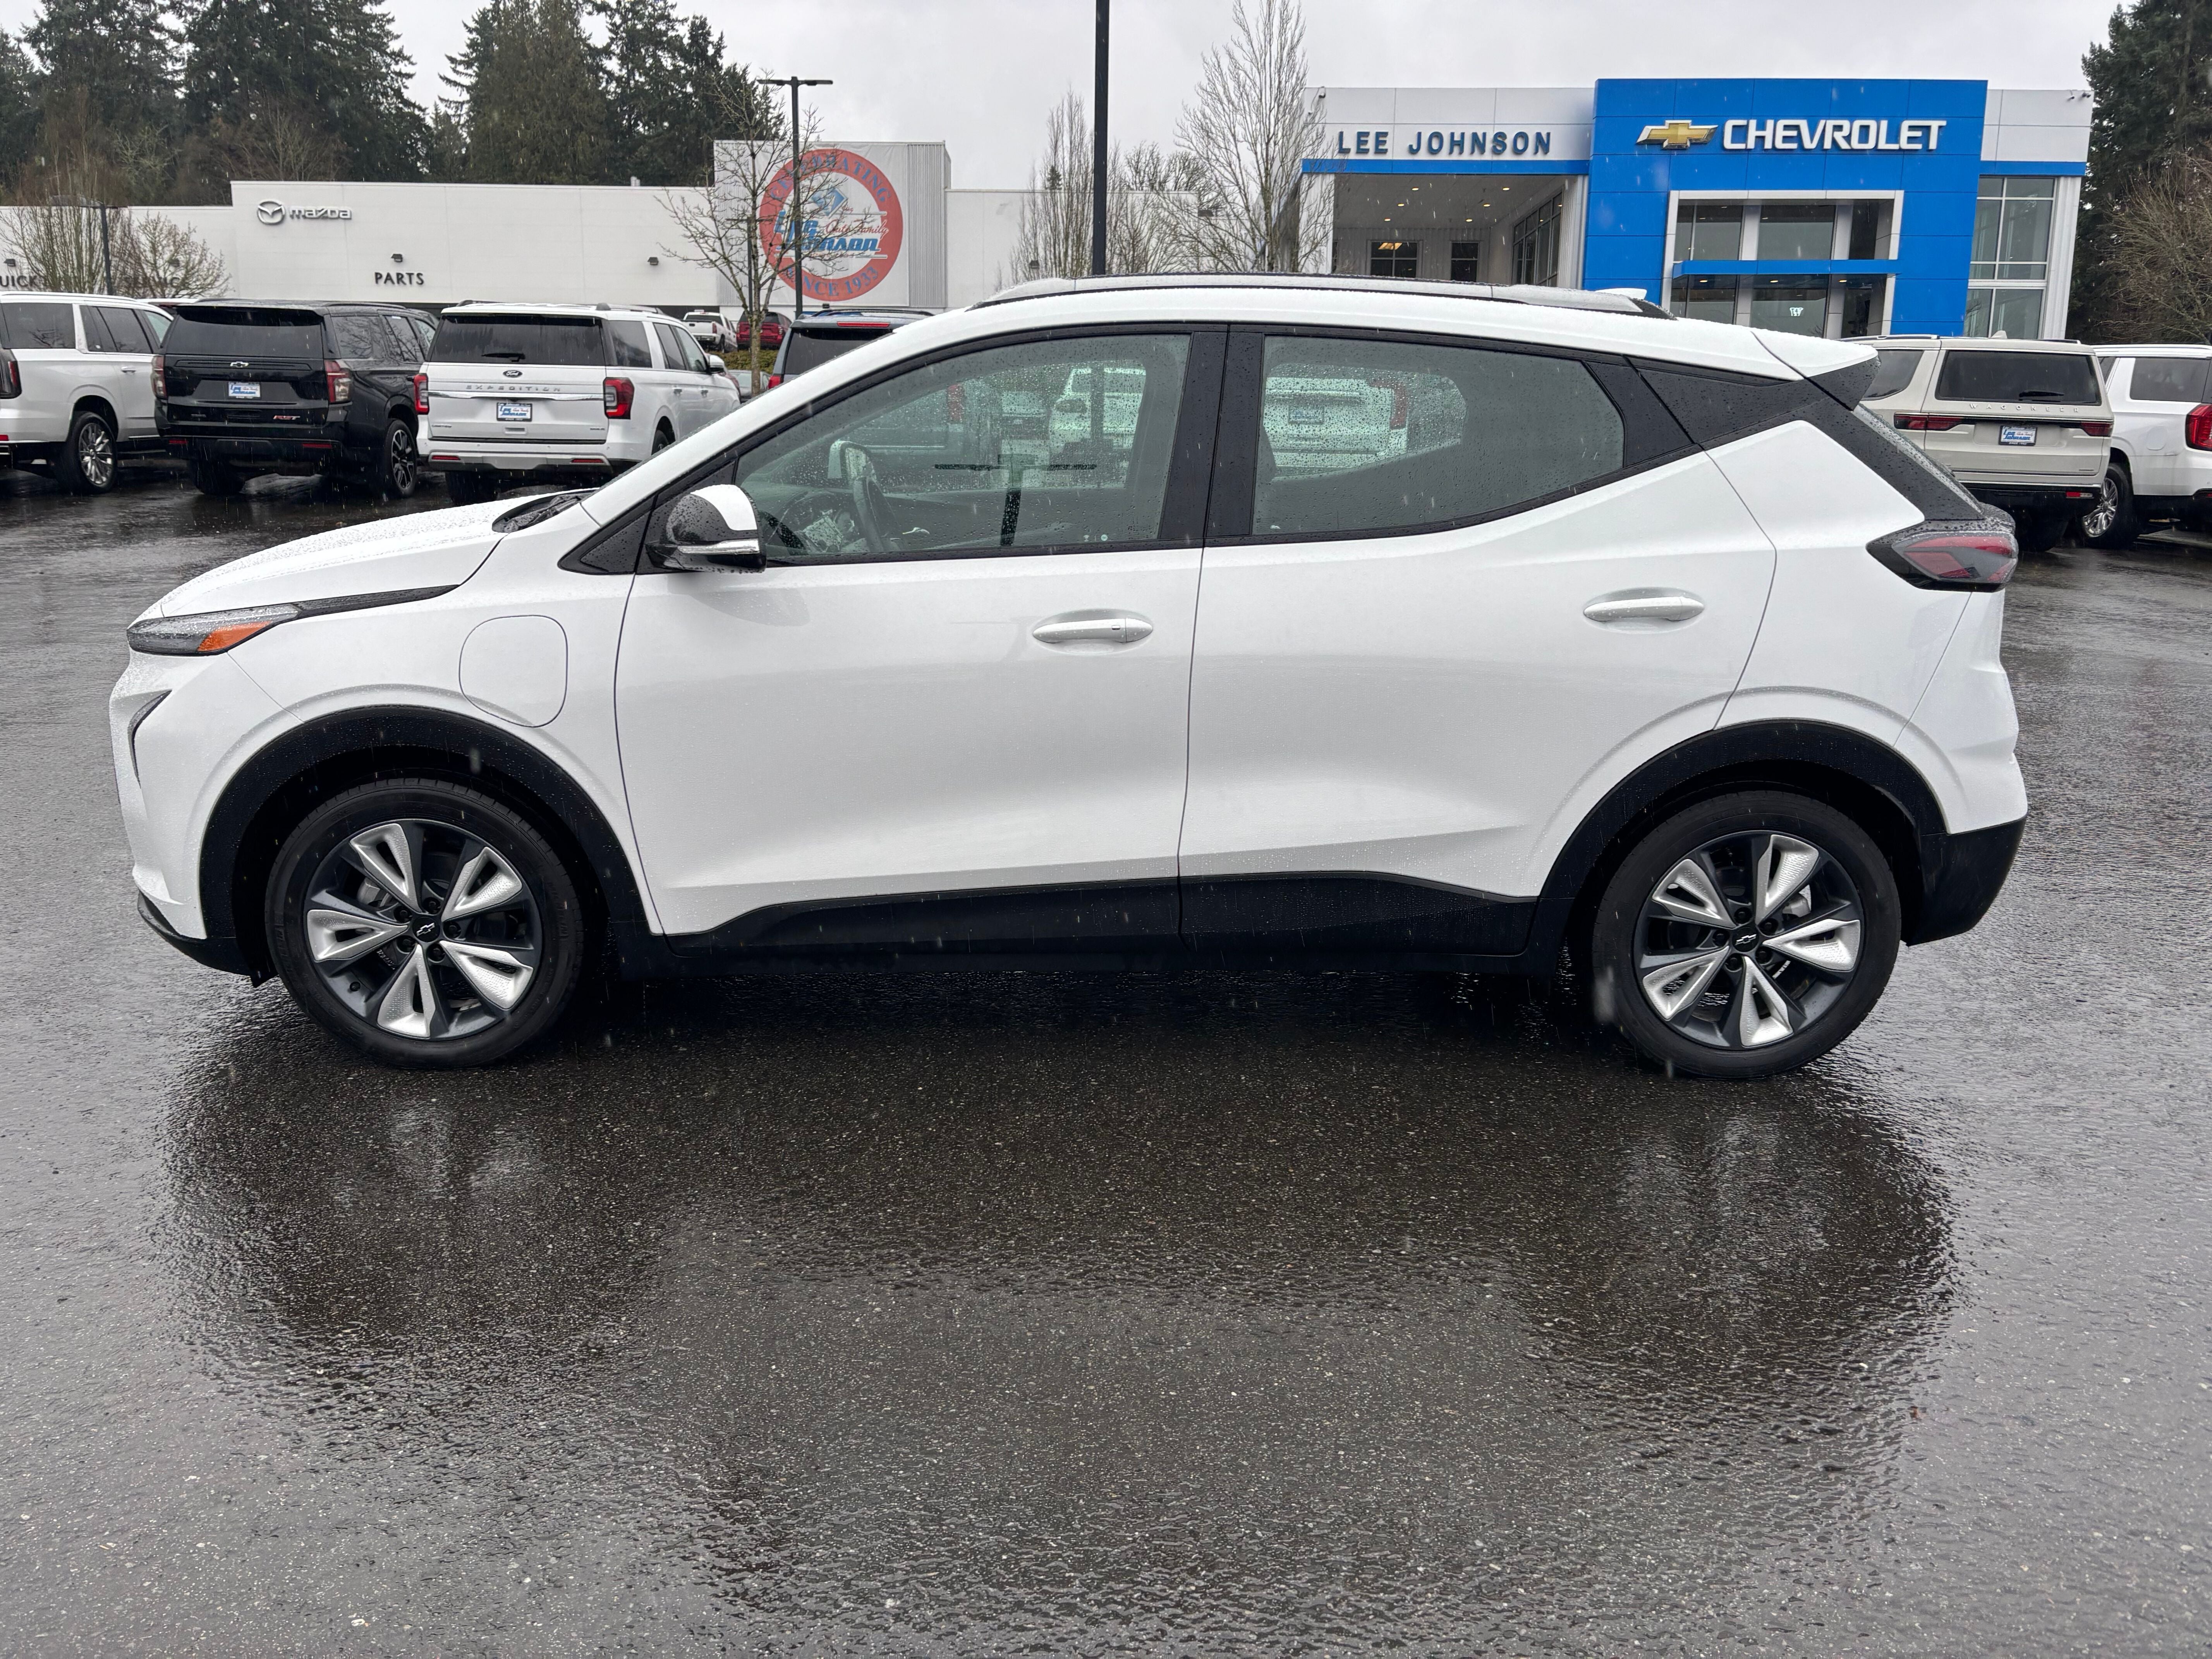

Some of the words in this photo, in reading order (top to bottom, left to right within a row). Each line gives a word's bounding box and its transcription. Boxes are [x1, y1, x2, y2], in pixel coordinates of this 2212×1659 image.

[1338, 131, 1389, 154] LEE
[1408, 131, 1551, 155] JOHNSON
[1723, 119, 1947, 150] CHEVROLET
[771, 154, 890, 202] CEEBRATING
[290, 207, 352, 220] mazda
[774, 210, 819, 233] Le
[375, 272, 424, 285] PARTS
[782, 267, 839, 297] SNCE
[845, 266, 879, 294] 1933
[1970, 404, 2079, 413] WAGONEER
